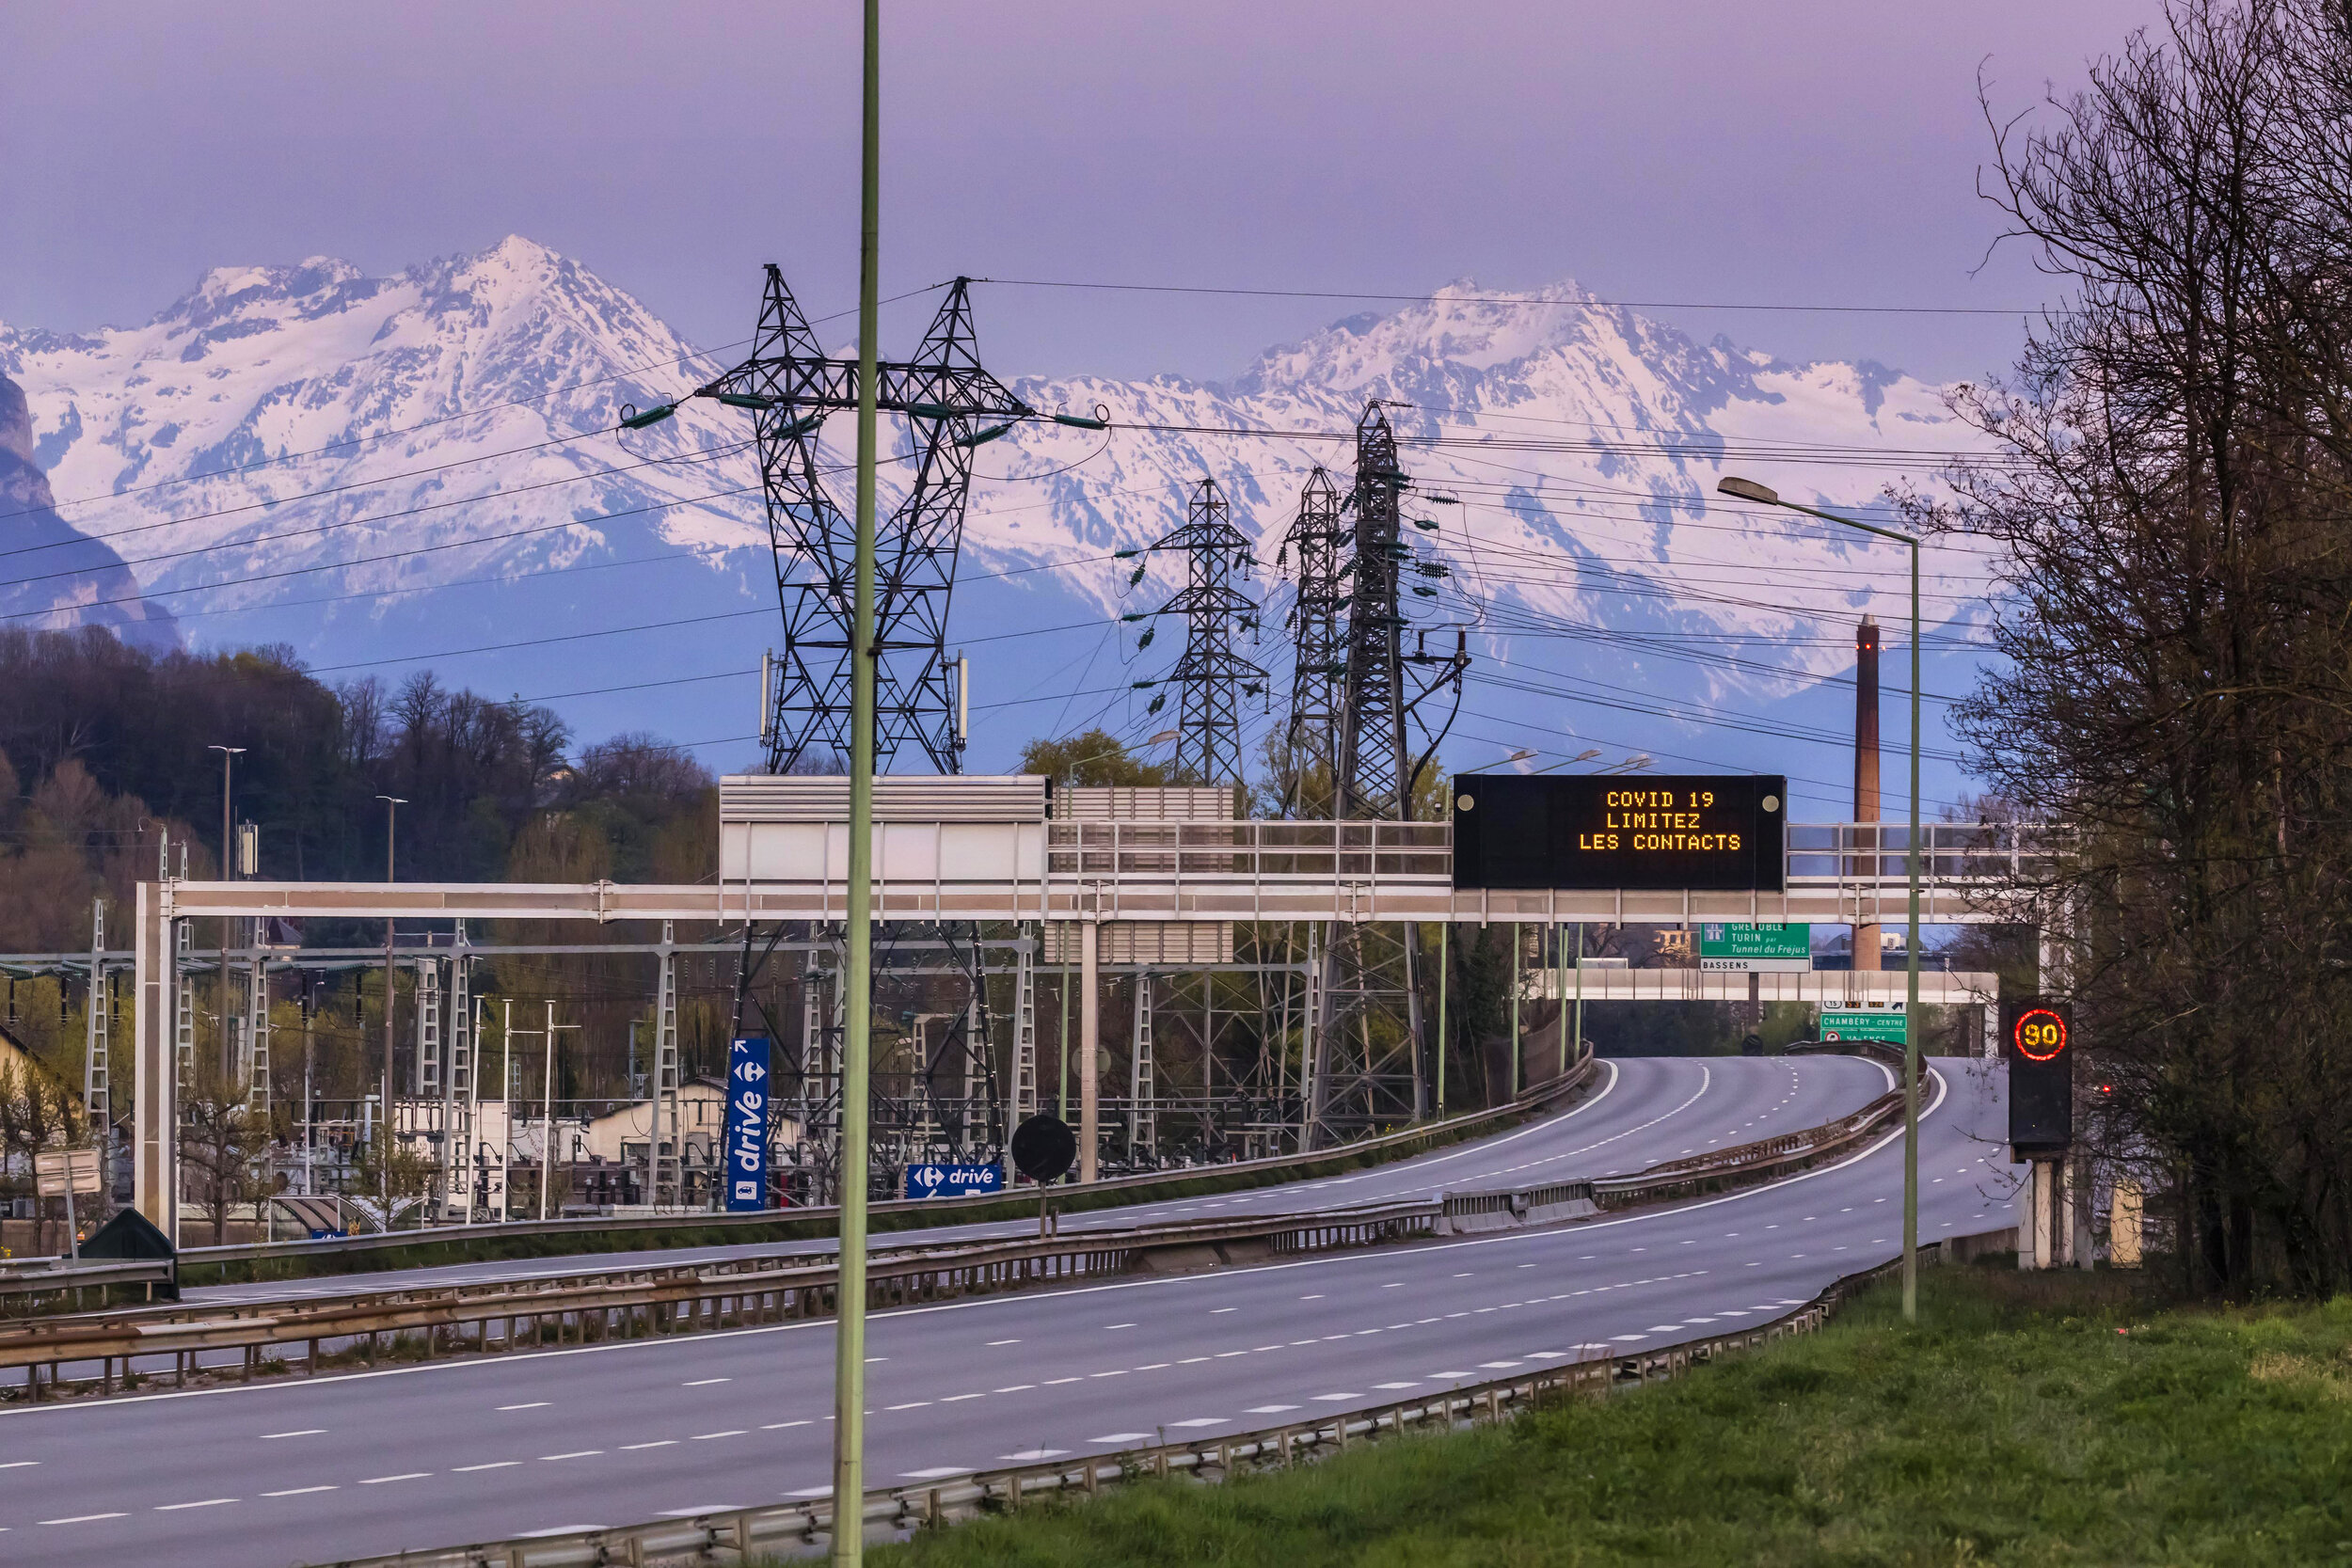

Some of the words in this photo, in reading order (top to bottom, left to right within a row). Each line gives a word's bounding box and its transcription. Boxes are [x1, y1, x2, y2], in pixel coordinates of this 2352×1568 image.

[1607, 791, 1673, 807] COVID
[1690, 791, 1714, 807] 19
[1607, 813, 1700, 829] LIMITEZ
[1580, 833, 1619, 850] LES
[1634, 833, 1740, 850] CONTACTS
[1732, 923, 1783, 931] GREOBLE
[1732, 933, 1761, 942] TURIN
[1732, 944, 1762, 953] Tunnel
[1765, 944, 1775, 954] du
[1777, 944, 1806, 955] Fréjus
[1823, 1017, 1870, 1026] CHAMBÉRY
[2025, 1023, 2058, 1046] 90
[735, 1091, 763, 1172] drive
[949, 1168, 994, 1184] drive
